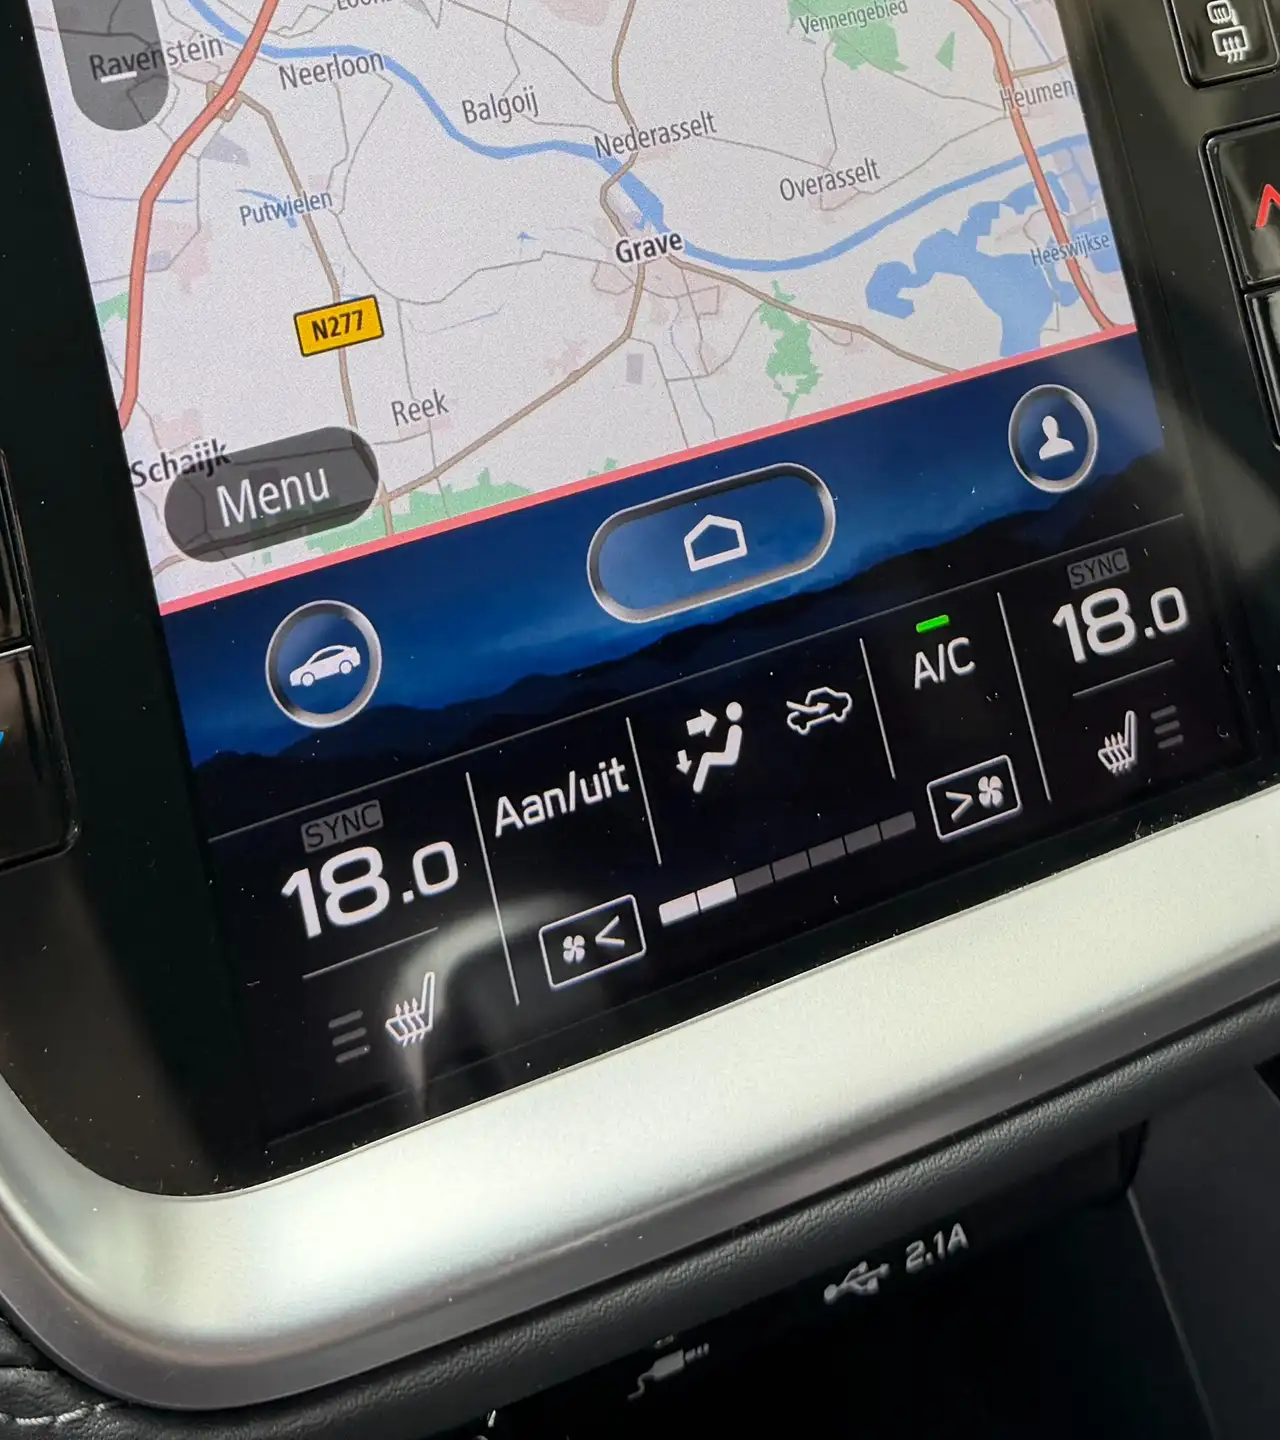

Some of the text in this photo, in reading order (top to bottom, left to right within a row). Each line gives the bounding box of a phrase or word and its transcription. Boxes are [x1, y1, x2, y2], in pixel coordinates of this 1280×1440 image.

[88, 35, 225, 81] Ravenstein
[278, 52, 385, 90] Neerloon
[461, 85, 539, 125] Balgoij
[1000, 79, 1076, 111] Heumen
[593, 110, 718, 159] Nederasselt
[778, 157, 881, 202] Overasselt
[239, 189, 334, 227] Putwielen
[615, 231, 684, 263] Grave
[1030, 234, 1110, 266] Heeswijkse
[311, 309, 366, 342] N277
[391, 389, 450, 427] Reek
[130, 438, 232, 489] Schaijk
[216, 468, 332, 529] Menu
[1069, 551, 1129, 587] SYNC
[1052, 585, 1190, 664] 18.0
[913, 636, 977, 691] A/C
[493, 756, 631, 838] Aan/uit
[305, 805, 381, 850] SYNC
[280, 840, 461, 940] 18.0
[905, 1222, 970, 1273] 2.1A
